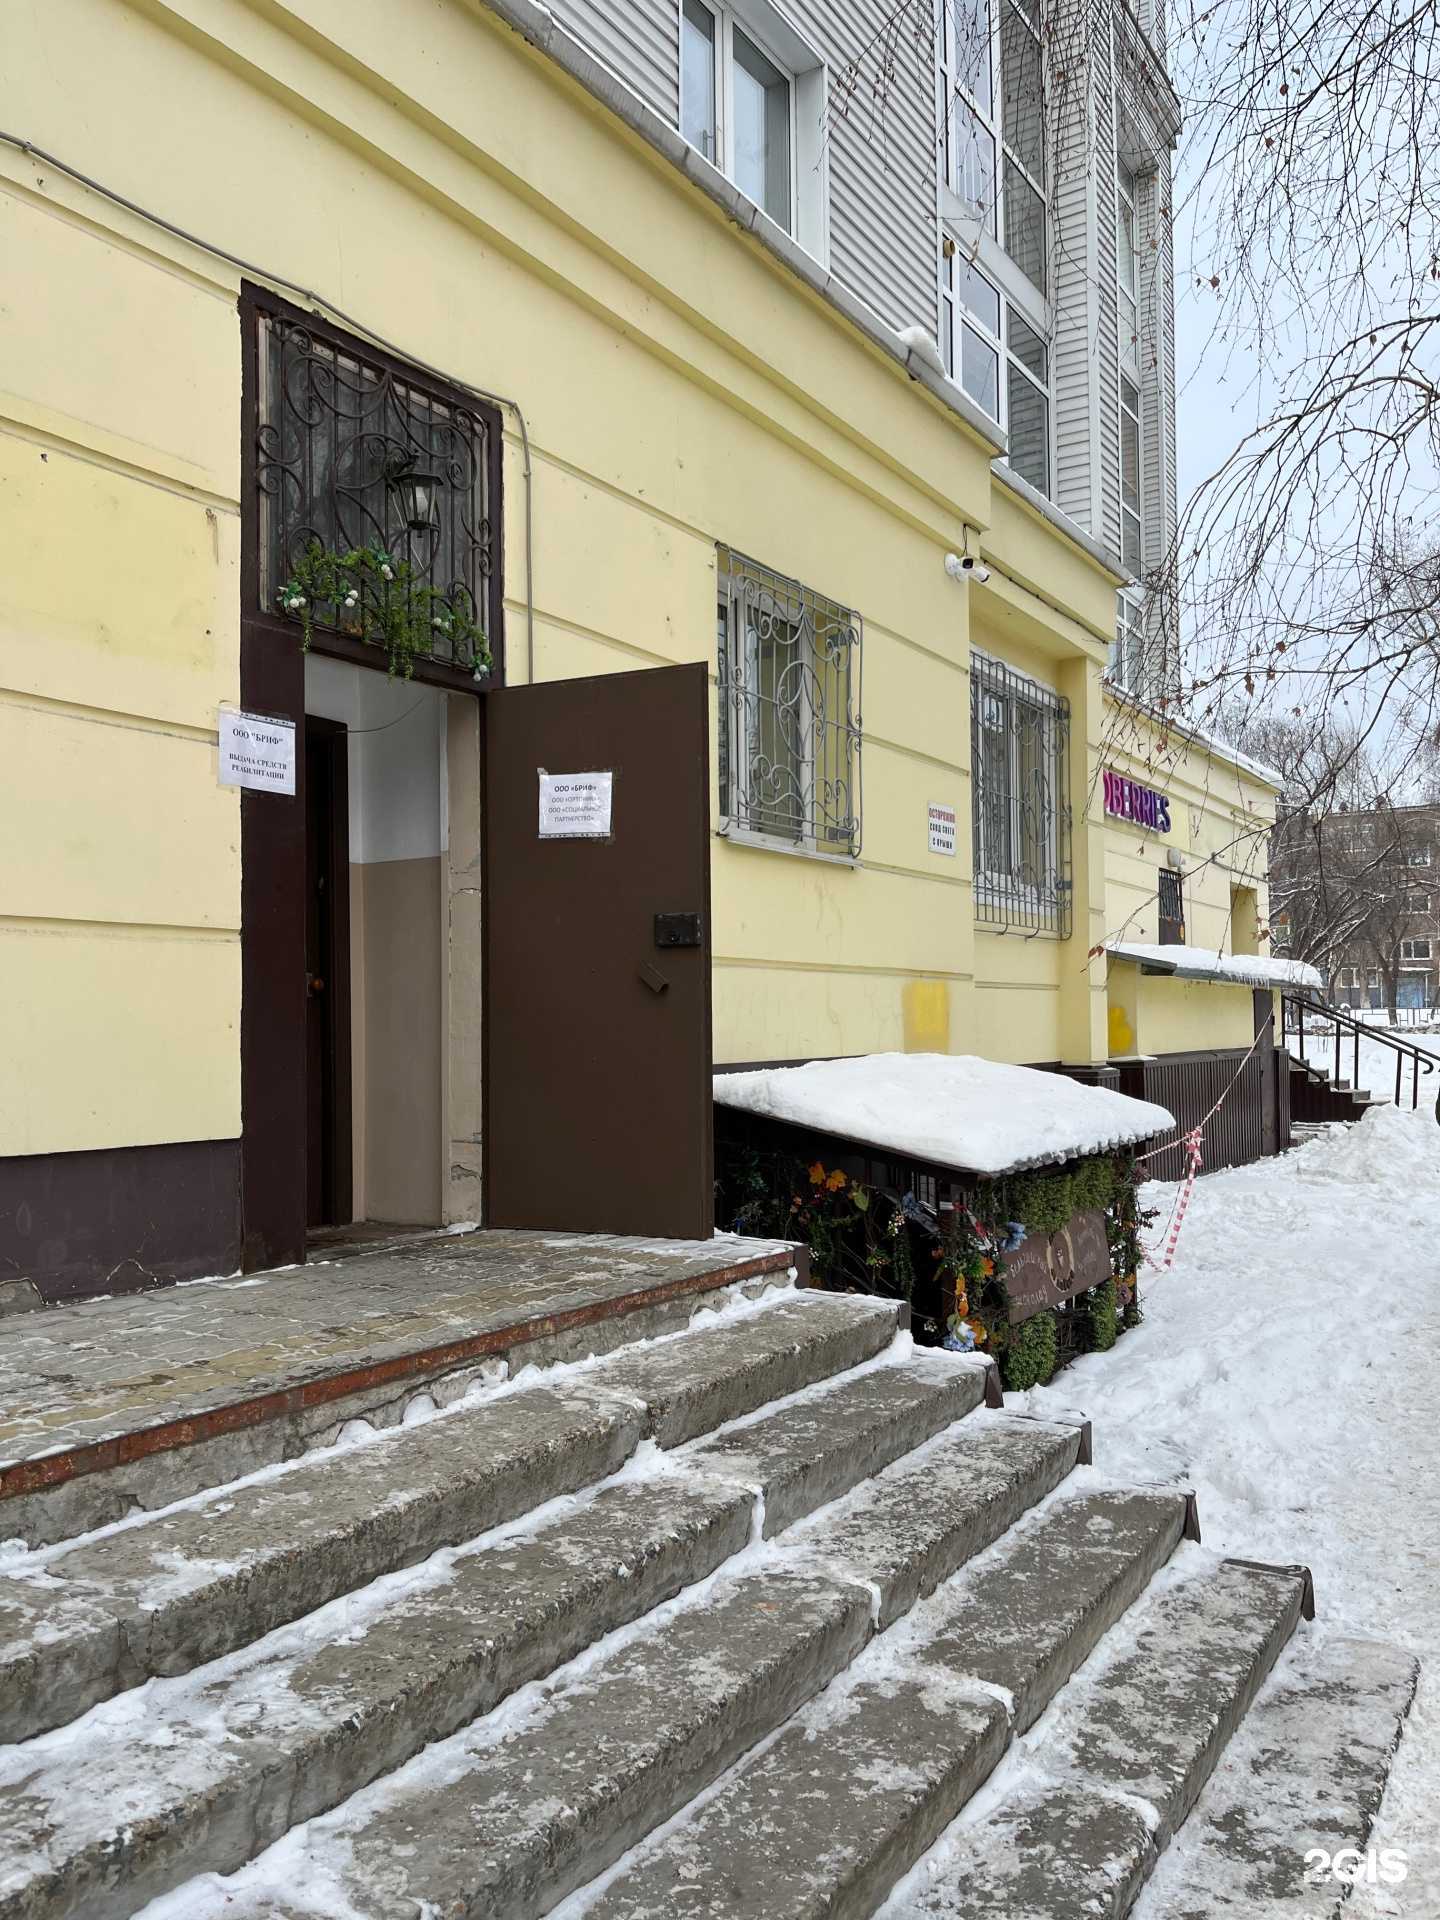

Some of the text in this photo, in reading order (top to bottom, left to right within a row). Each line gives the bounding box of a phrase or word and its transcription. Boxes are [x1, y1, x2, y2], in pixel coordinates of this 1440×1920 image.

[232, 727, 284, 745] ООО "БРИФ"
[229, 752, 256, 765] ВЫДАЧА
[554, 785, 570, 793] ООО
